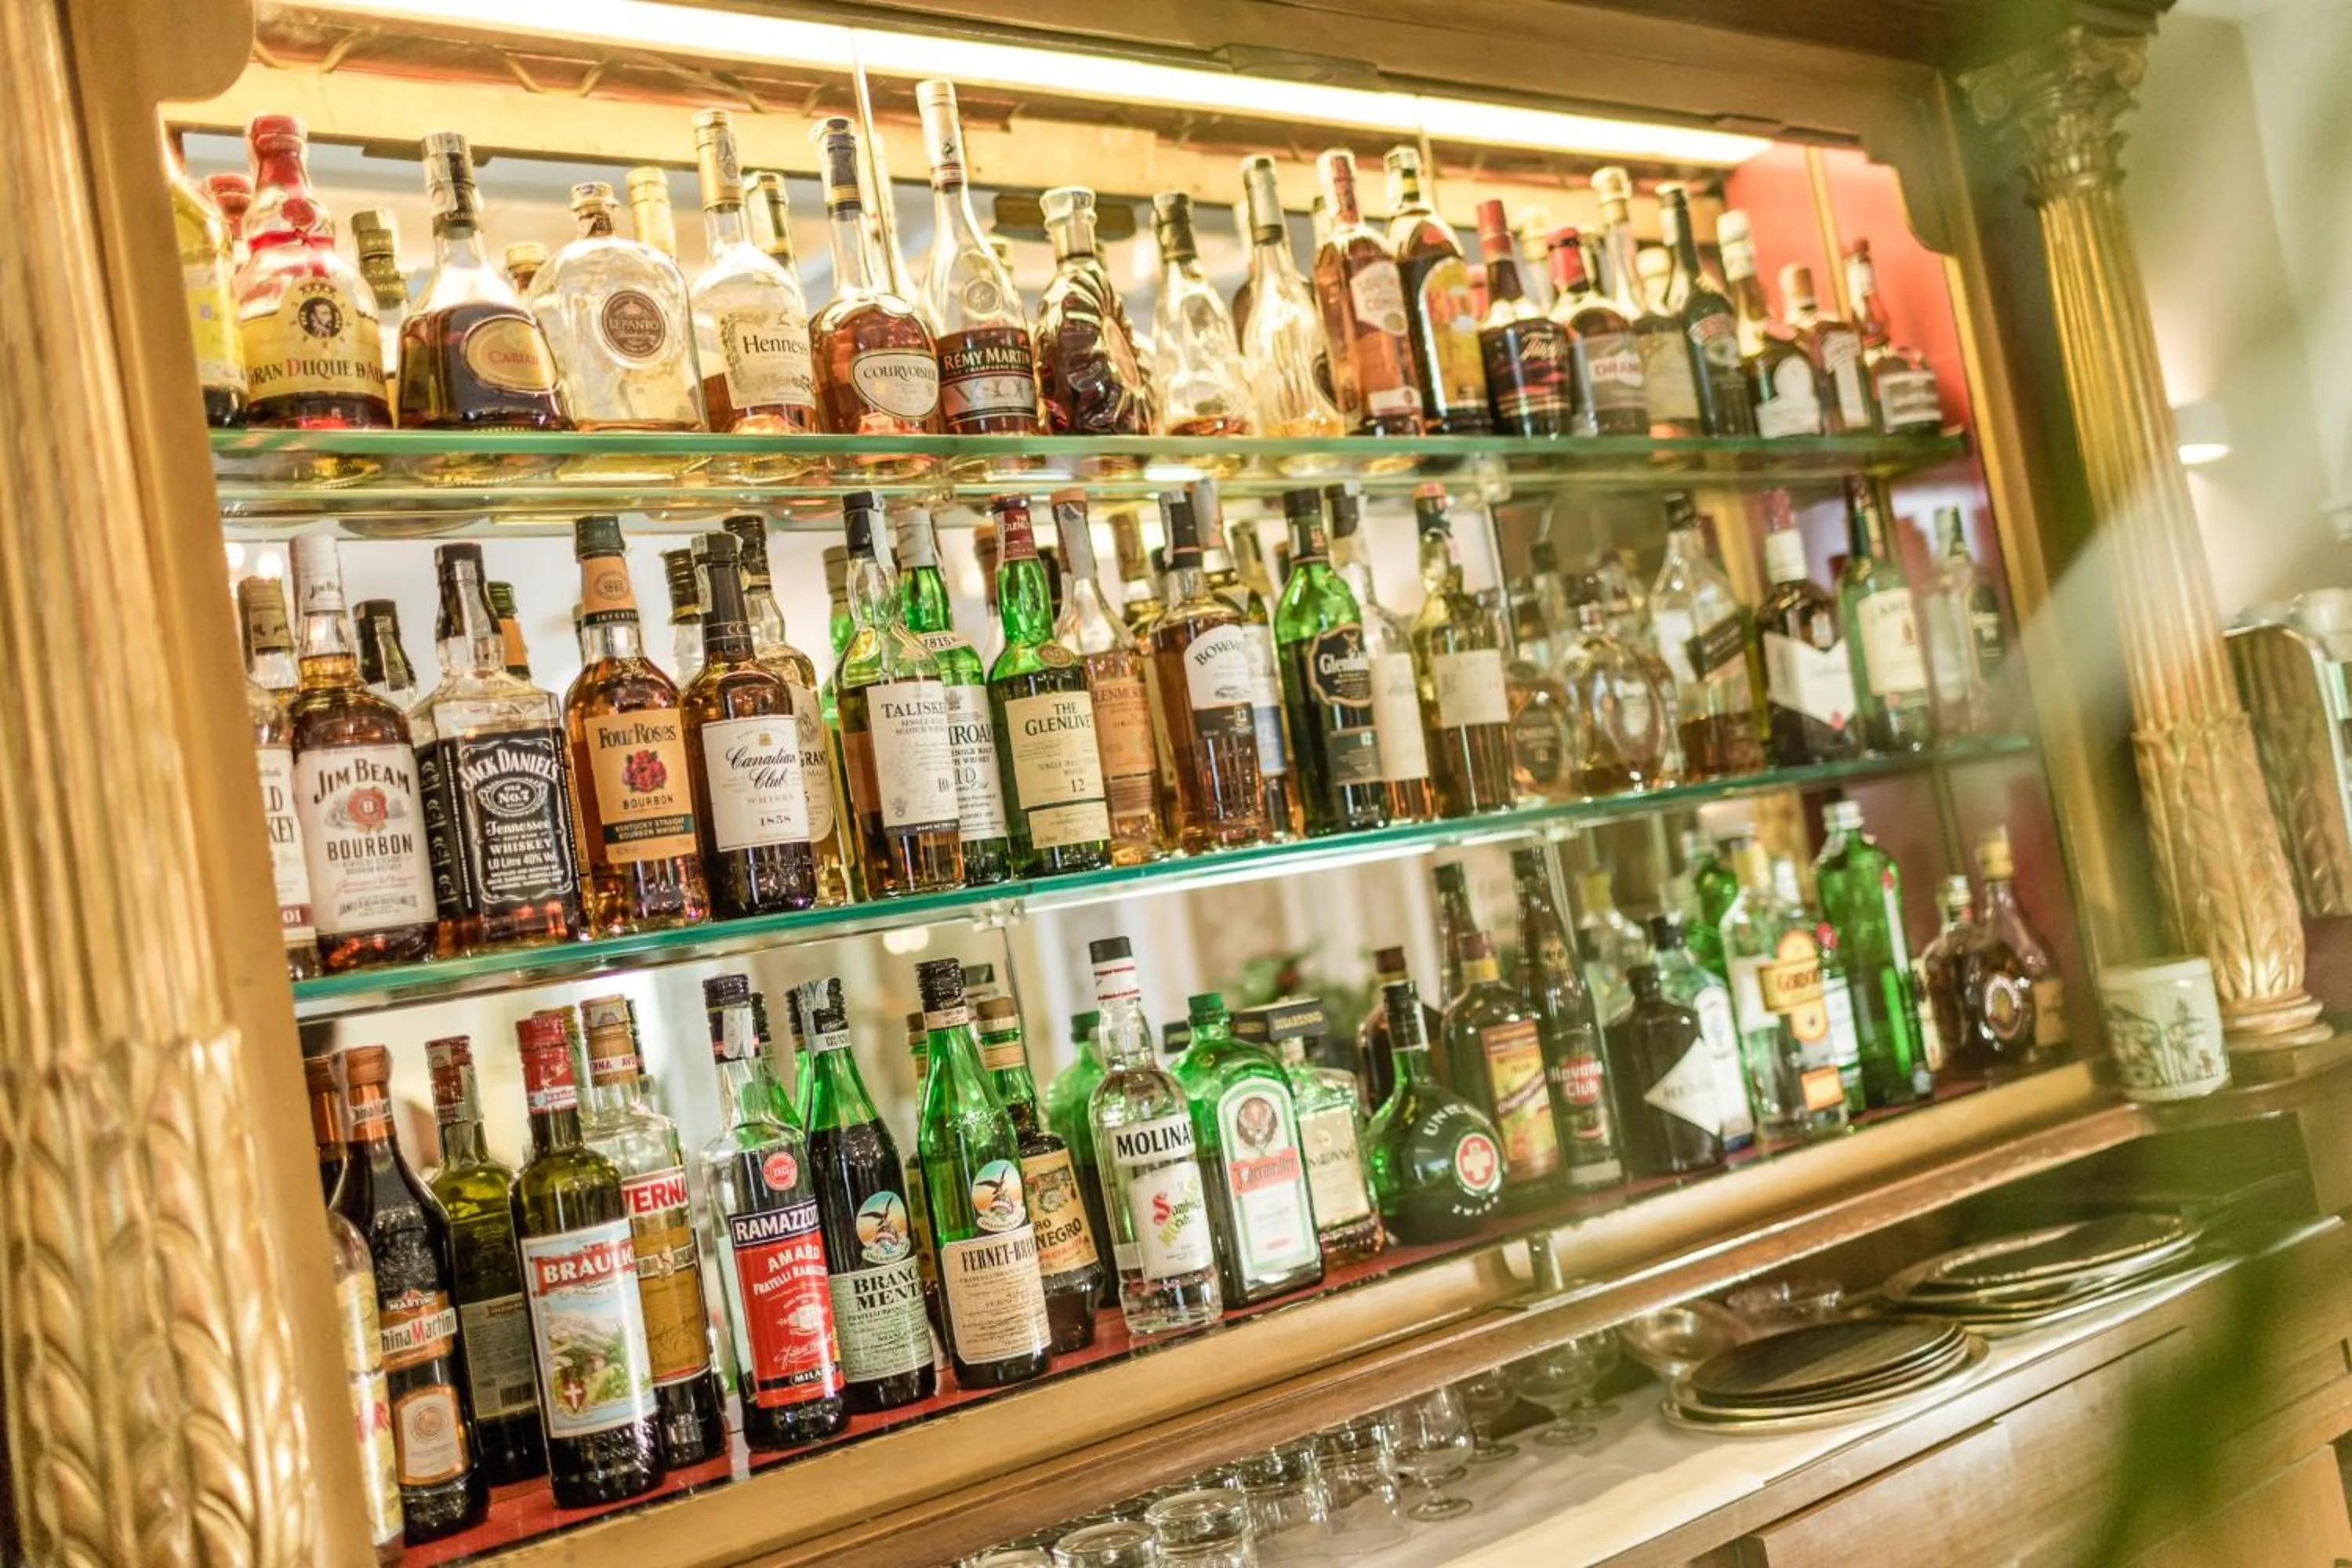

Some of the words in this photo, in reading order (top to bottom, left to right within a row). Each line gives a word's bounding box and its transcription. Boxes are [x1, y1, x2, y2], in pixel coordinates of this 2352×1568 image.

[286, 358, 353, 380] DUQUE
[1054, 702, 1078, 716] THE
[725, 746, 797, 770] Canadian
[314, 765, 350, 804] JIM
[355, 757, 411, 797] BEAM
[457, 755, 499, 793] JACK
[750, 765, 790, 790] Club
[1070, 778, 1086, 793] 12
[622, 794, 674, 811] BOURBON
[326, 833, 413, 862] BOURBON
[768, 1243, 820, 1273] AMARO
